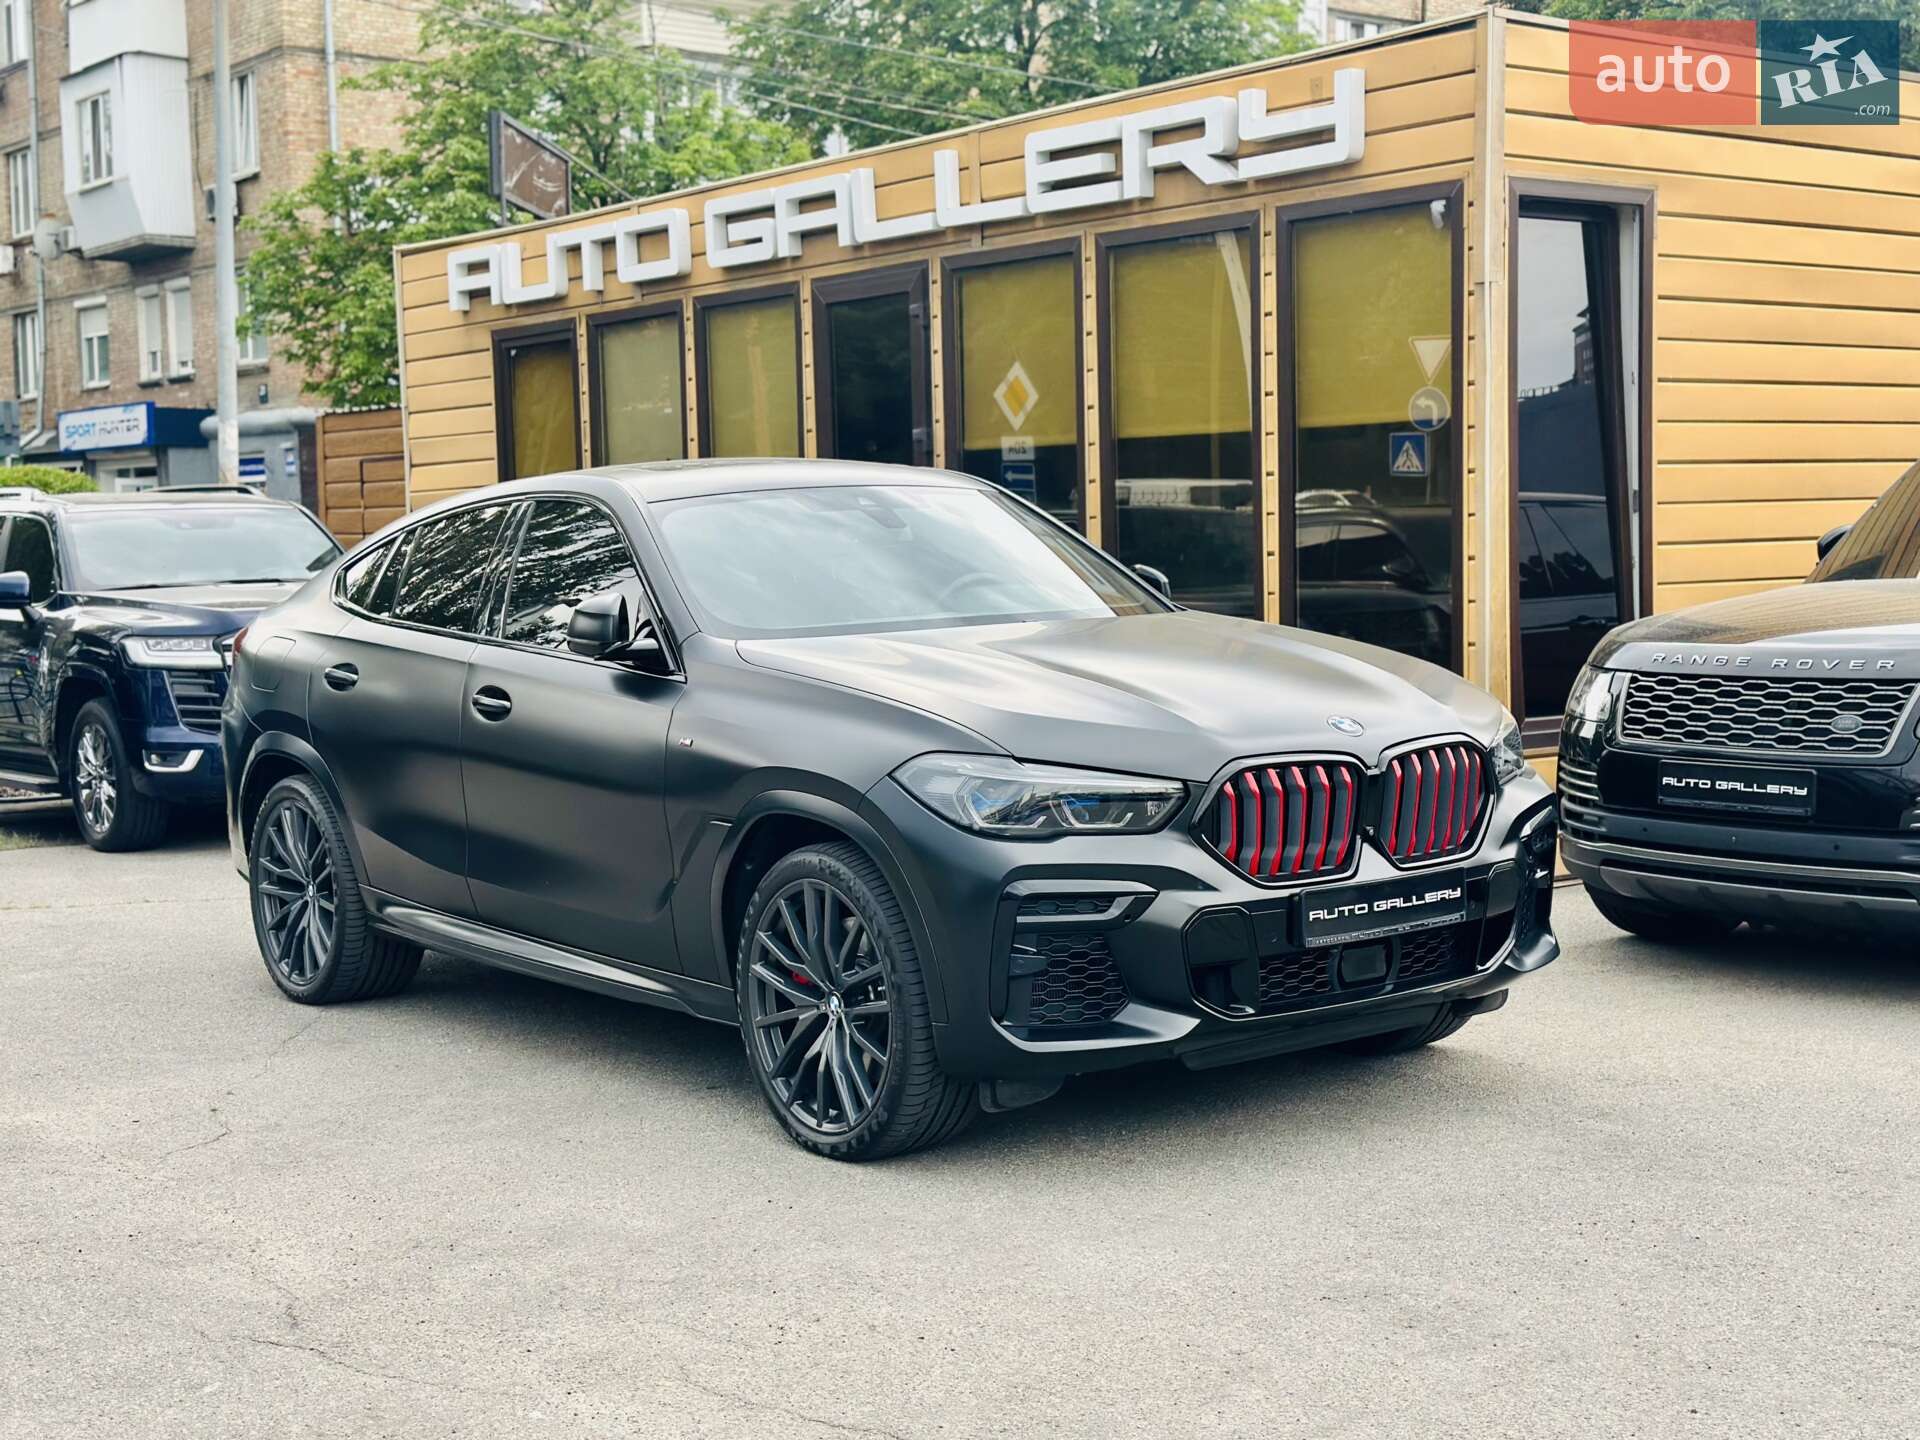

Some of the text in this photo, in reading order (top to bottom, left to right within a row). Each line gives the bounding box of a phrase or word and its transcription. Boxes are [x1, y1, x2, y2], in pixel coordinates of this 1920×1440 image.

[448, 68, 1366, 311] AUTO GALLERY
[65, 422, 96, 439] SPORT
[1651, 653, 1895, 671] RANGE ROVER
[1662, 776, 1808, 796] AUTO GALLERY
[1308, 886, 1462, 922] AUTO GALLERY
